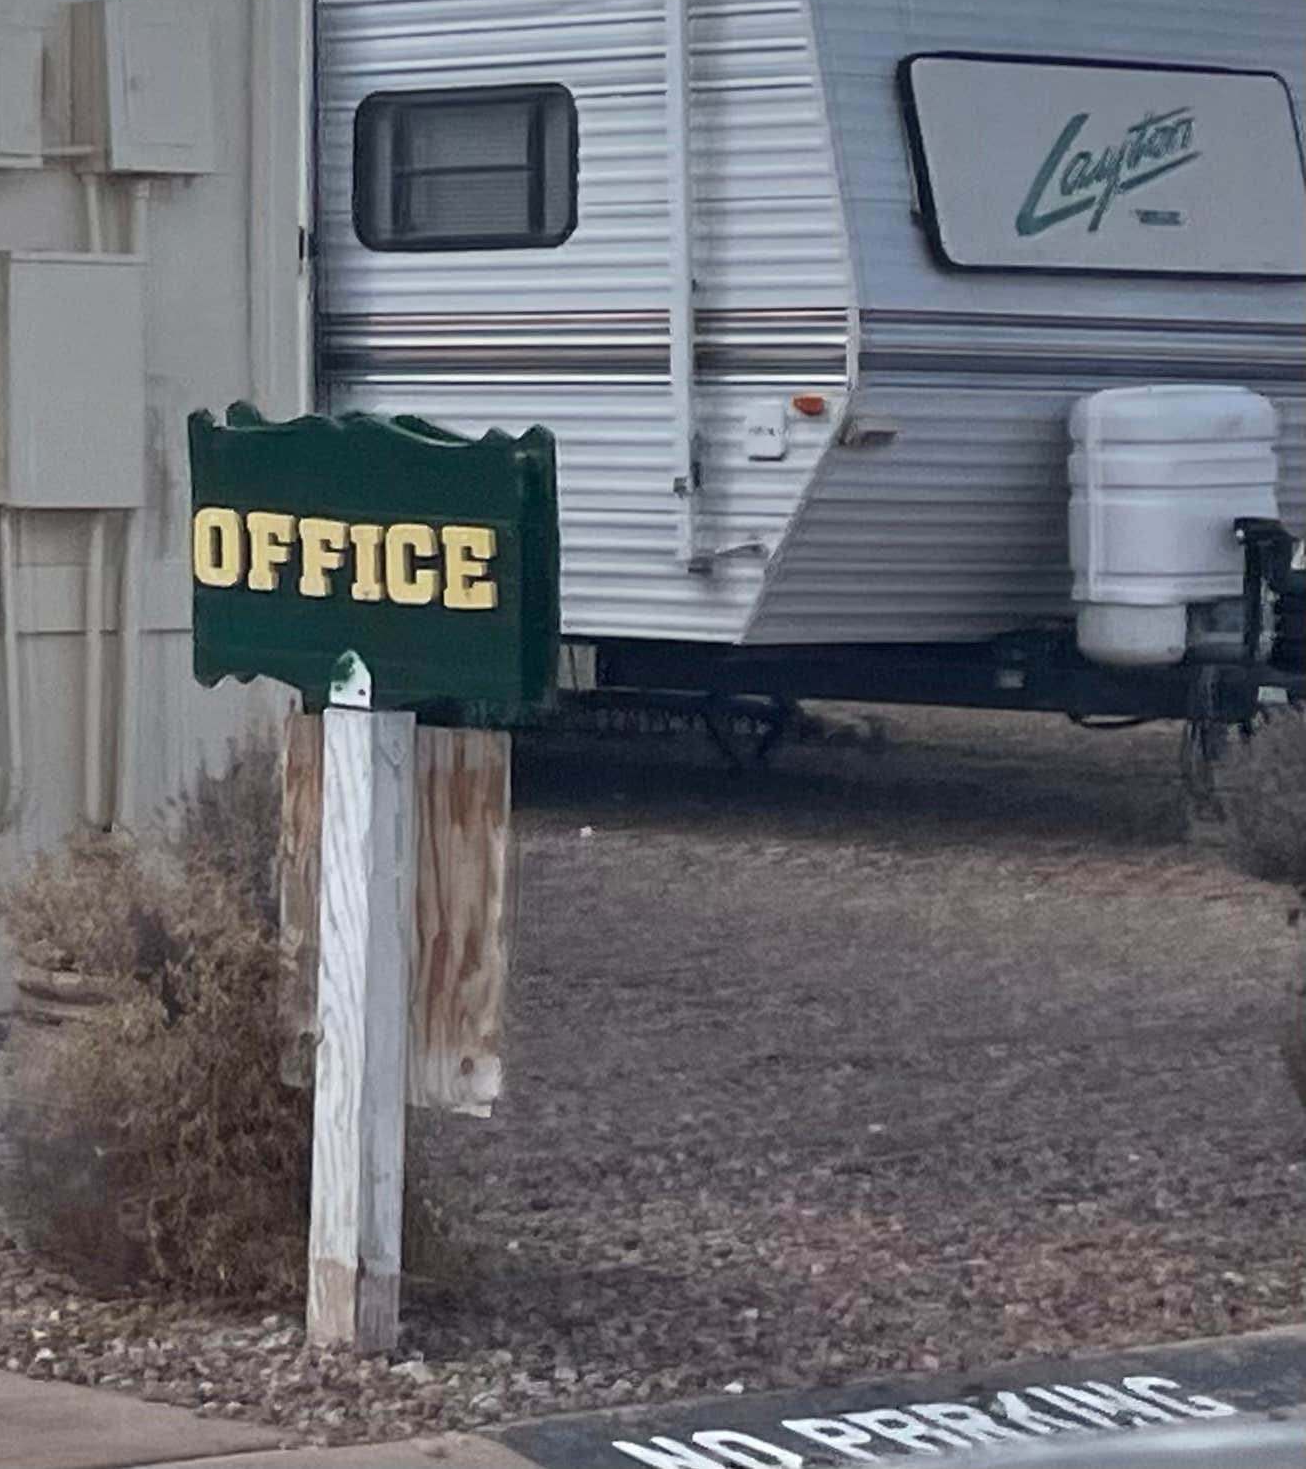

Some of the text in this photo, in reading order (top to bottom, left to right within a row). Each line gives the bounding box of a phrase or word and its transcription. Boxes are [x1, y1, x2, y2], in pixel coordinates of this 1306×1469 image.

[1015, 107, 1200, 236] Layton
[193, 507, 498, 610] OFFICE
[611, 1375, 1238, 1469] NO PARKING
